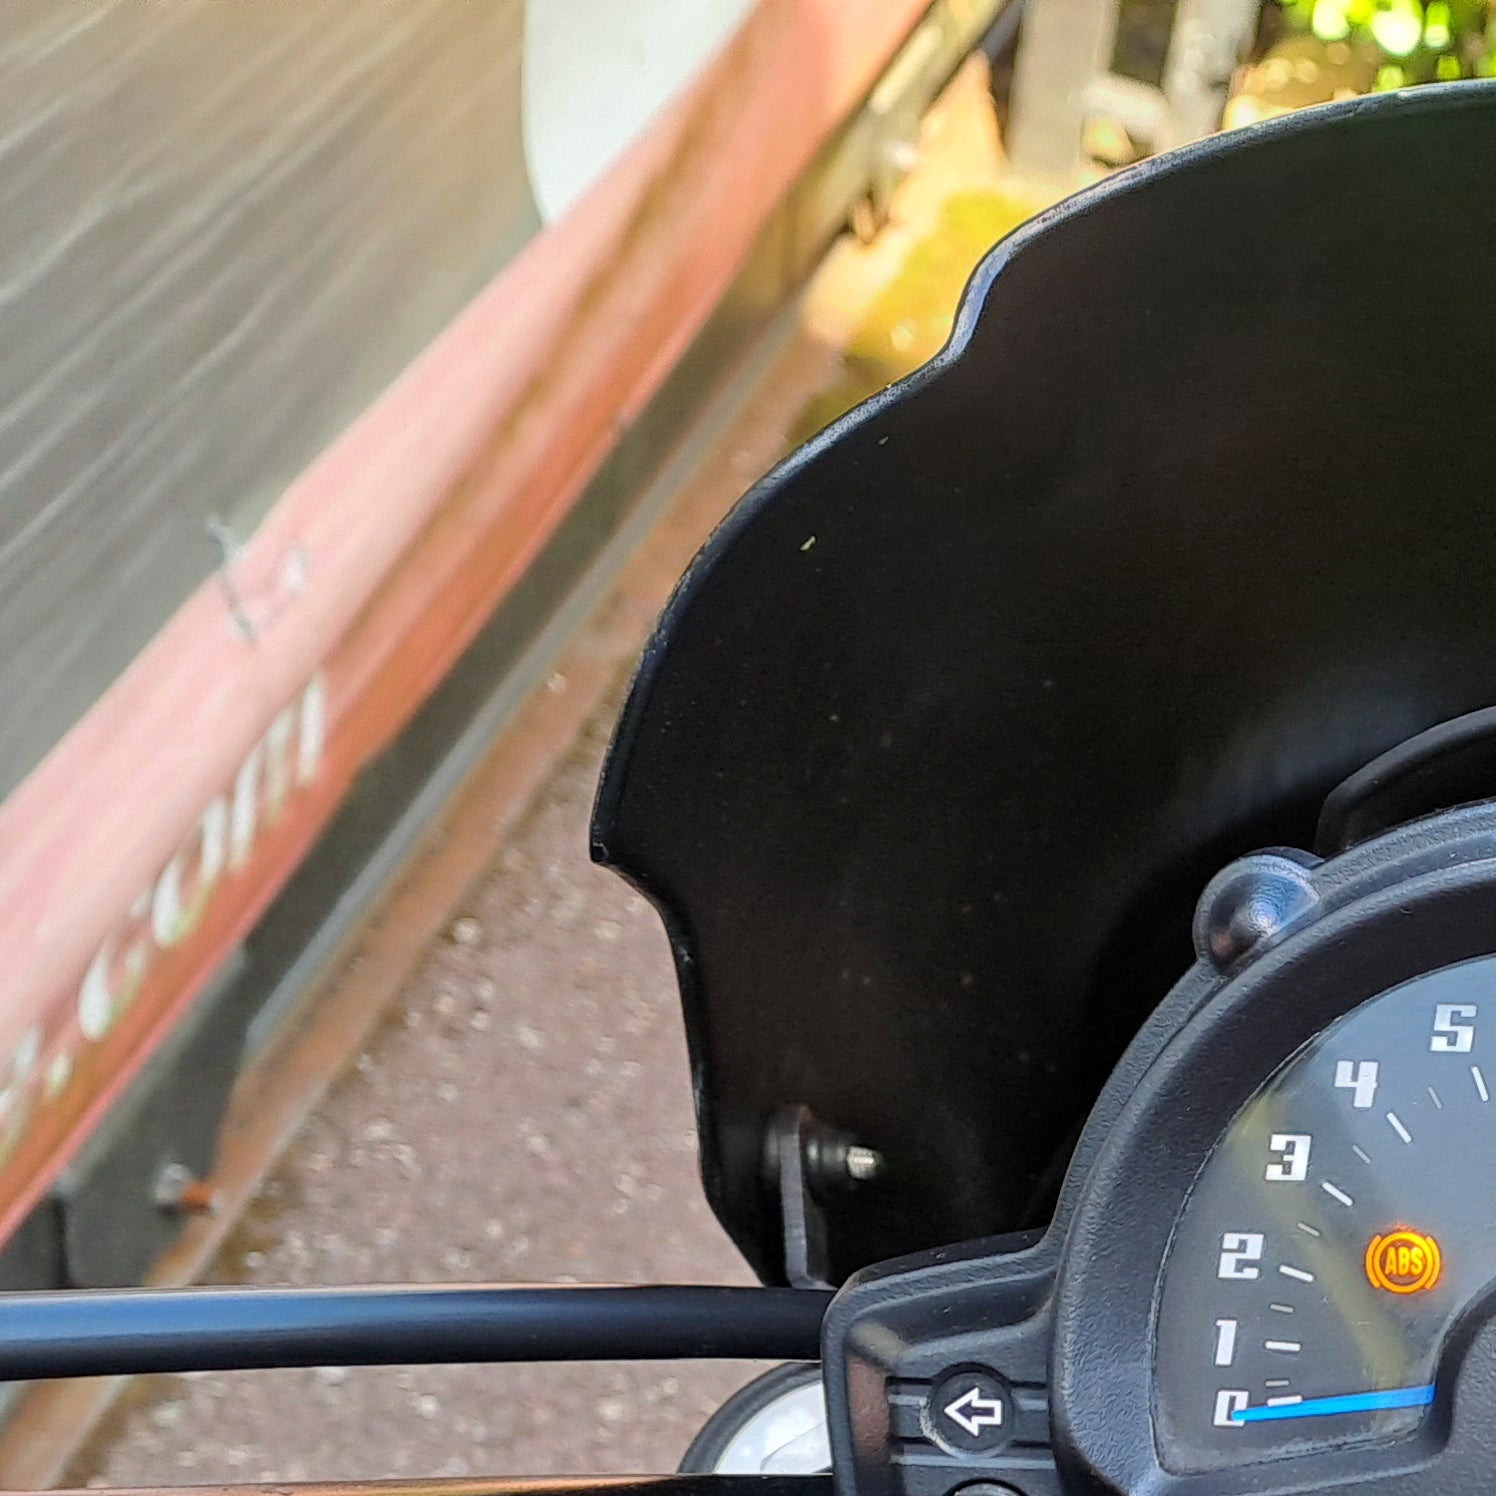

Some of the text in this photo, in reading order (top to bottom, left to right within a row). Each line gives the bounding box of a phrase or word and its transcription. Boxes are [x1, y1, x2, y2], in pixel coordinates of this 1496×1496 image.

[1430, 1004, 1478, 1052] 5
[1334, 1060, 1378, 1107] 4
[1264, 1134, 1312, 1181] 3
[1218, 1233, 1264, 1279] 2
[1384, 1246, 1425, 1276] ABS
[1214, 1319, 1238, 1366] 1
[1213, 1390, 1250, 1427] 0
